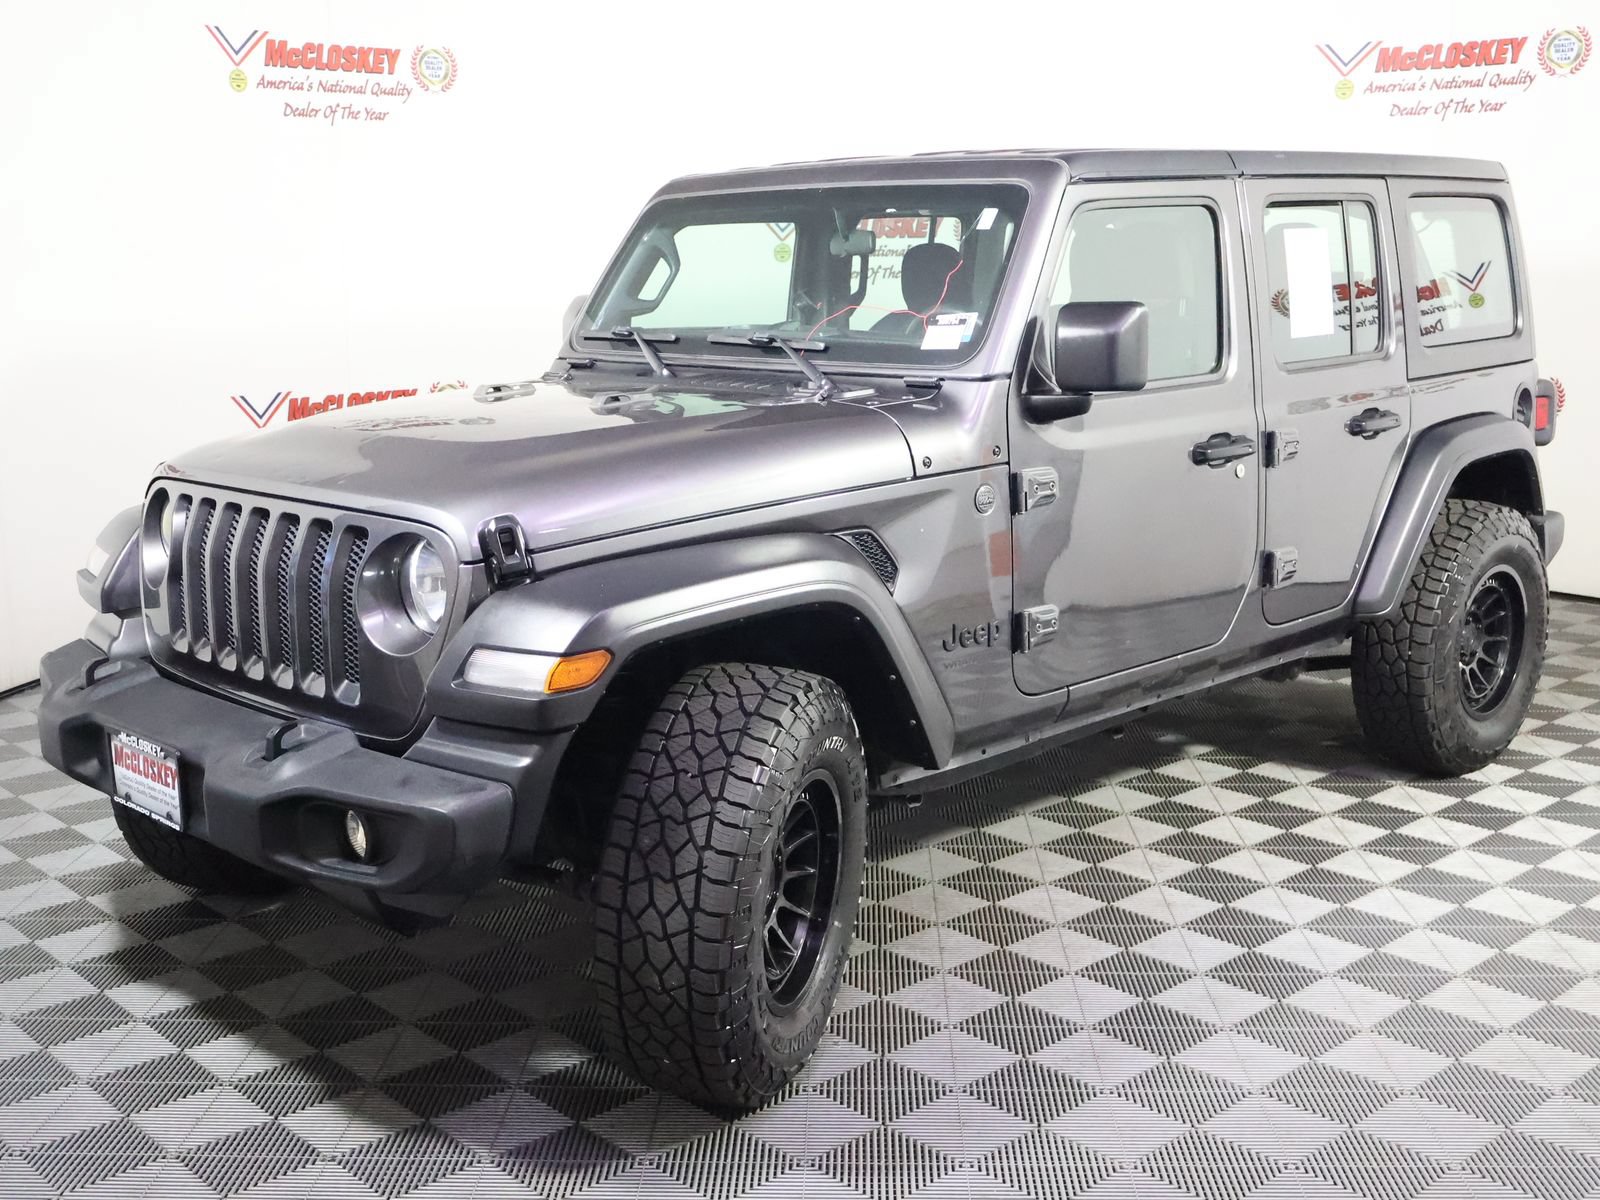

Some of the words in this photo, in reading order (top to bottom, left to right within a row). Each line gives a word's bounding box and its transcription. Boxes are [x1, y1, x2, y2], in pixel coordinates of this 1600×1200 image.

[264, 39, 401, 75] McCLOSKEY
[1375, 36, 1528, 73] McCLOSKEY
[256, 74, 313, 92] America's
[317, 79, 368, 95] National
[371, 81, 413, 104] Quality
[1363, 76, 1426, 95] America's
[1430, 71, 1488, 91] National
[1489, 69, 1536, 92] Quality
[283, 102, 321, 118] Dealer
[323, 103, 339, 126] Of
[341, 103, 361, 120] The
[364, 107, 389, 121] Year
[1389, 100, 1432, 117] Dealer
[1434, 99, 1453, 122] Of
[1453, 98, 1475, 114] The
[1478, 99, 1507, 113] Year
[882, 265, 902, 279] The
[943, 619, 1000, 652] Jeep
[121, 731, 161, 758] McCLOSKEY
[114, 743, 177, 790] McCLOSKEY
[114, 796, 150, 816] COLORADO
